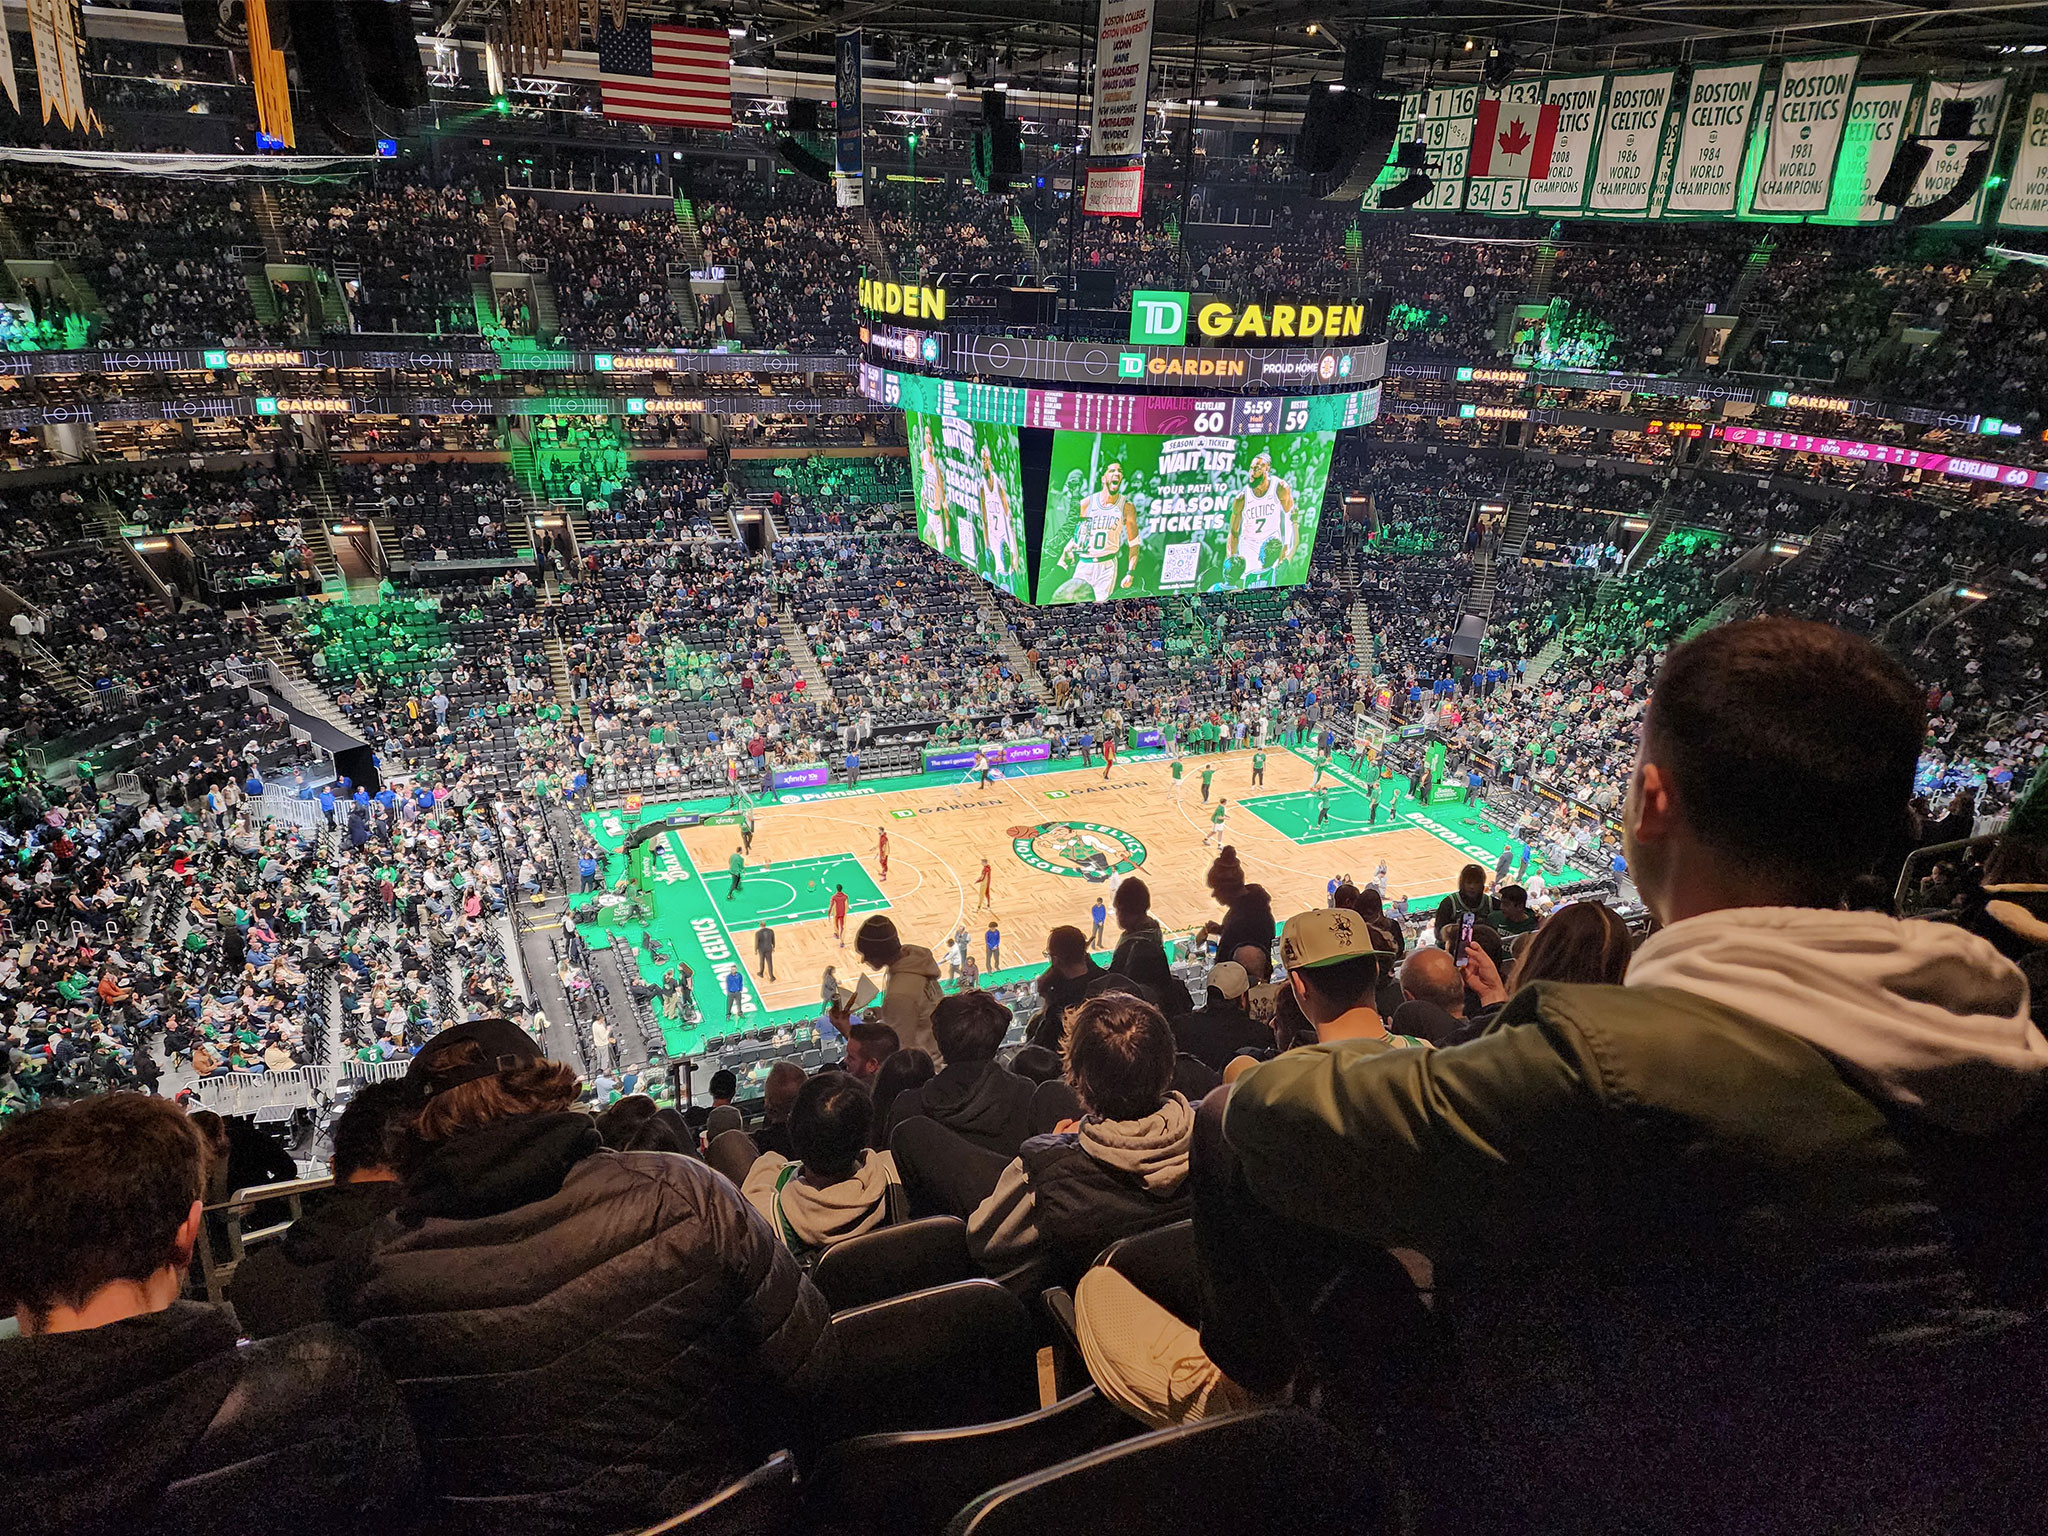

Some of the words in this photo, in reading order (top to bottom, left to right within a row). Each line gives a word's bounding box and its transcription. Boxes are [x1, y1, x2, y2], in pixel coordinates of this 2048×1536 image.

[1694, 81, 1752, 104] BOSTON
[1783, 73, 1849, 98] BOSTON
[1434, 94, 1442, 116] 1
[1456, 90, 1474, 114] 16
[1550, 90, 1596, 110] BOSTON
[1612, 88, 1665, 109] BOSTON
[1402, 96, 1417, 120] 14
[1692, 104, 1744, 127] CELTICS
[1782, 98, 1840, 123] CELTICS
[1852, 100, 1902, 120] OSTON
[1611, 110, 1658, 130] CELTICS
[1427, 123, 1444, 146] 19
[1552, 152, 1570, 163] 2008
[1617, 150, 1638, 162] 1986
[1698, 148, 1721, 162] 1984
[1790, 144, 1813, 159] 1981
[1446, 152, 1464, 176] 18
[1609, 166, 1640, 179] WORLD
[1690, 164, 1724, 179] WORLD
[1778, 162, 1816, 177] WORLD
[1444, 184, 1455, 206] 2
[1470, 184, 1490, 207] 34
[1502, 185, 1512, 206] 5
[1534, 181, 1578, 194] CHAMPIONS
[1596, 182, 1646, 196] CHAMPIONS
[1674, 181, 1732, 196] CHAMPIONS
[1762, 180, 1823, 194] CHAMPIONS
[859, 276, 946, 320] GARDEN
[1138, 300, 1183, 335] TD
[1198, 303, 1365, 338] GARDEN
[226, 353, 300, 366] GARDEN
[612, 356, 674, 369] GARDEN
[1122, 357, 1142, 373] TD
[1148, 358, 1244, 376] GARDEN
[1263, 364, 1294, 374] PROUD
[1296, 362, 1318, 373] HOME
[1472, 370, 1526, 382] GARDEN
[884, 383, 900, 404] 59
[276, 400, 348, 412] GARDEN
[644, 400, 703, 412] GARDEN
[1194, 402, 1226, 411] CLEVELAND
[1243, 400, 1272, 414] 5:59
[1788, 394, 1850, 412] GARDEN
[1285, 410, 1308, 431] 59
[1475, 407, 1528, 419] GARDEN
[1194, 412, 1224, 432] 60
[1169, 440, 1194, 450] SEASON
[1208, 439, 1229, 448] TICKET
[1772, 438, 1781, 446] 15
[1158, 451, 1202, 475] WAIT
[1202, 450, 1236, 472] LIST
[1948, 458, 2000, 480] CLEVELAND
[2006, 470, 2029, 484] 60
[946, 469, 980, 497] SEASON
[1158, 485, 1184, 496] YOUR
[1187, 484, 1212, 494] PATH
[1215, 482, 1228, 492] TO
[1149, 496, 1229, 515] SEASON
[1246, 503, 1275, 520] CELTICS
[1092, 516, 1120, 531] ELTICS
[1149, 514, 1226, 533] TICKETS
[1255, 518, 1267, 534] 7
[1094, 532, 1106, 550] 0
[1010, 750, 1030, 760] xfinity
[784, 774, 808, 784] xfinity
[802, 788, 875, 800] Putnam
[1070, 781, 1148, 795] GARDEN
[1540, 788, 1563, 802] GARDEN
[918, 800, 1004, 814] GARDEN
[1576, 806, 1600, 822] GARDEN
[715, 817, 735, 825] xfinity
[1405, 812, 1470, 846] BOSTON
[1084, 823, 1143, 854] CELTICS
[1016, 840, 1064, 874] BOSTON
[690, 916, 731, 961] CELTICS
